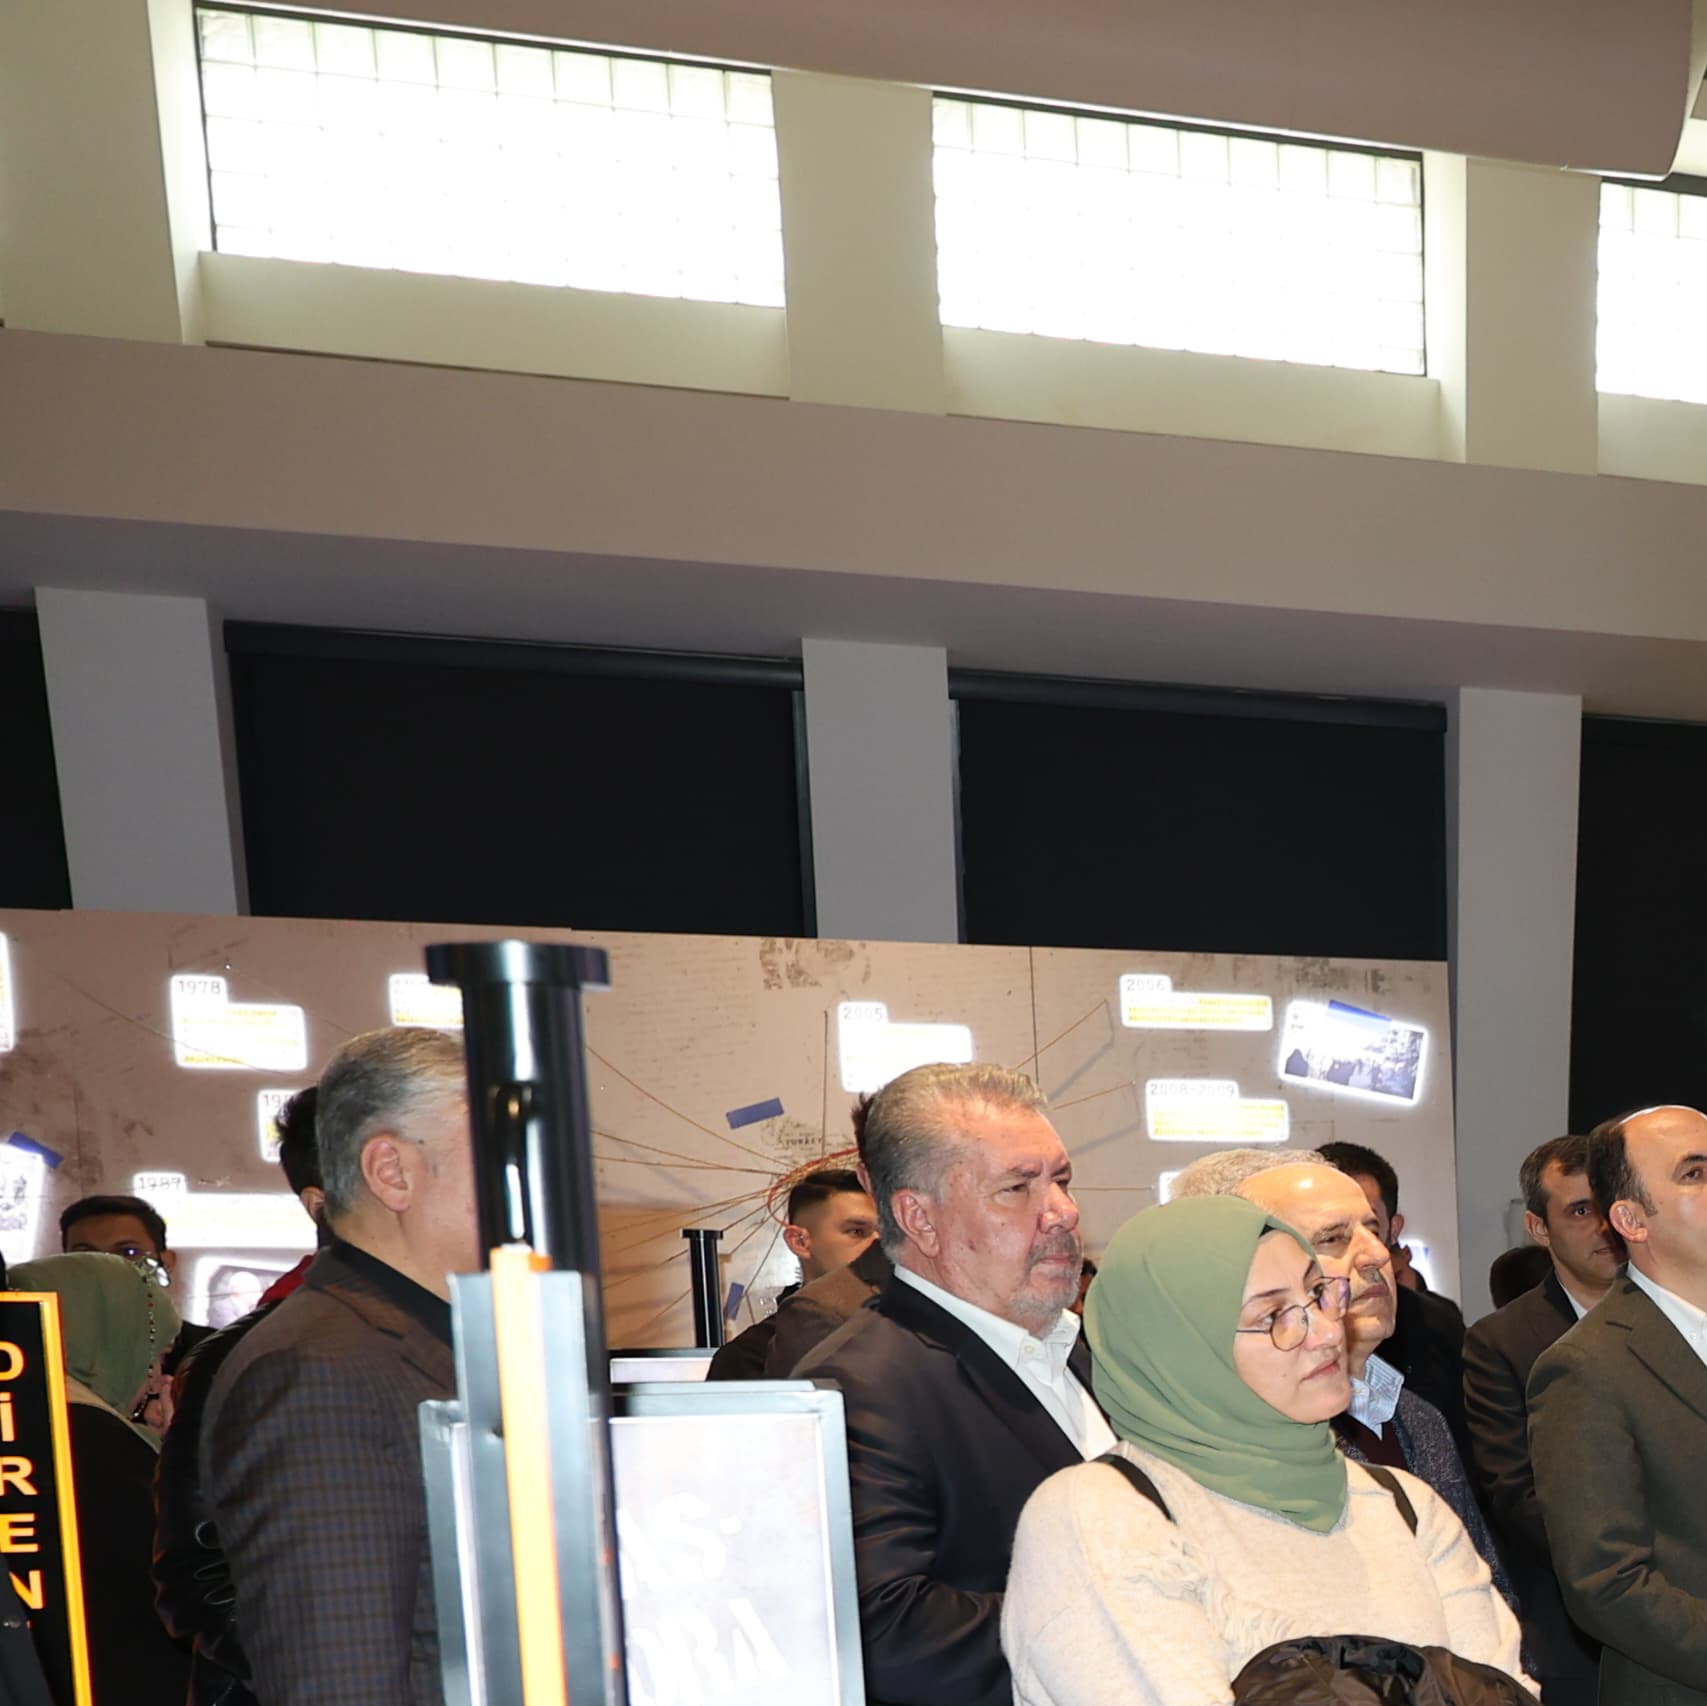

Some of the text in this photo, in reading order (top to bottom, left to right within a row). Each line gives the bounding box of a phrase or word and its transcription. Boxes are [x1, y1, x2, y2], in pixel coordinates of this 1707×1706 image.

[177, 978, 222, 996] 1978
[1126, 977, 1166, 993] 2006
[842, 1005, 884, 1021] 2005
[1149, 1082, 1236, 1097] 2008-2009
